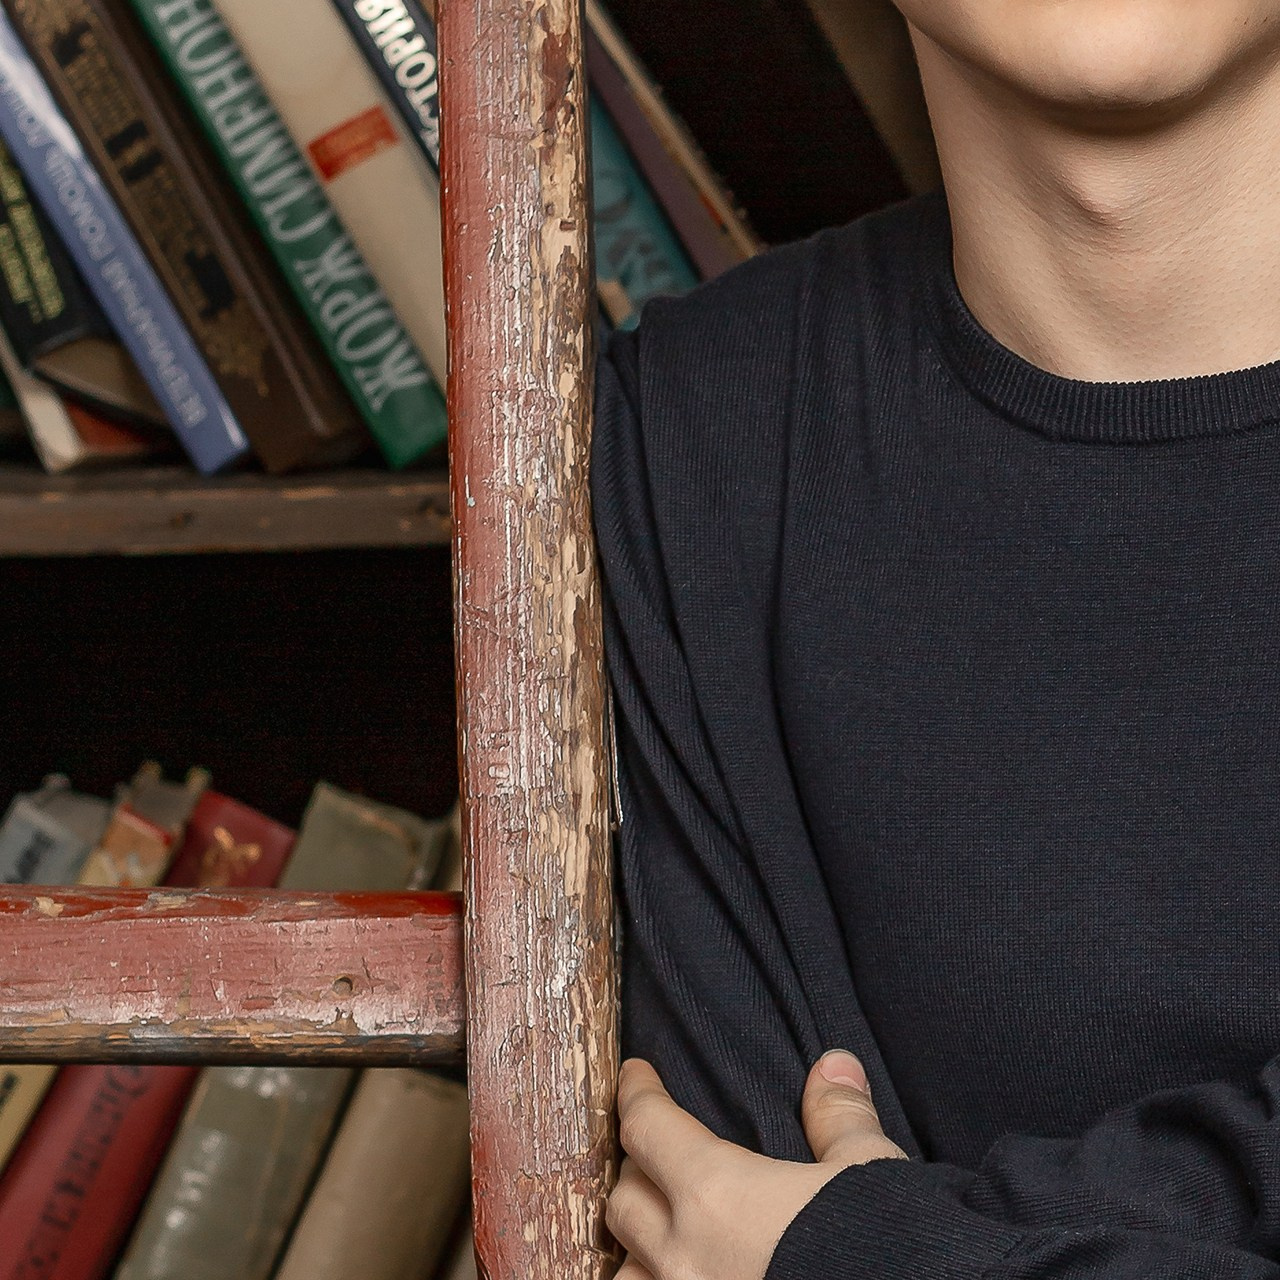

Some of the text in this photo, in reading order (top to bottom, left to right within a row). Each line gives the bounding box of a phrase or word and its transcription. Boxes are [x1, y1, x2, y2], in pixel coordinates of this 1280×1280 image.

[32, 139, 123, 264] ПОМОЩЬ
[95, 253, 212, 430] ВЕТЕРИНАРНАЯ
[288, 231, 432, 415] ЖОРЖ
